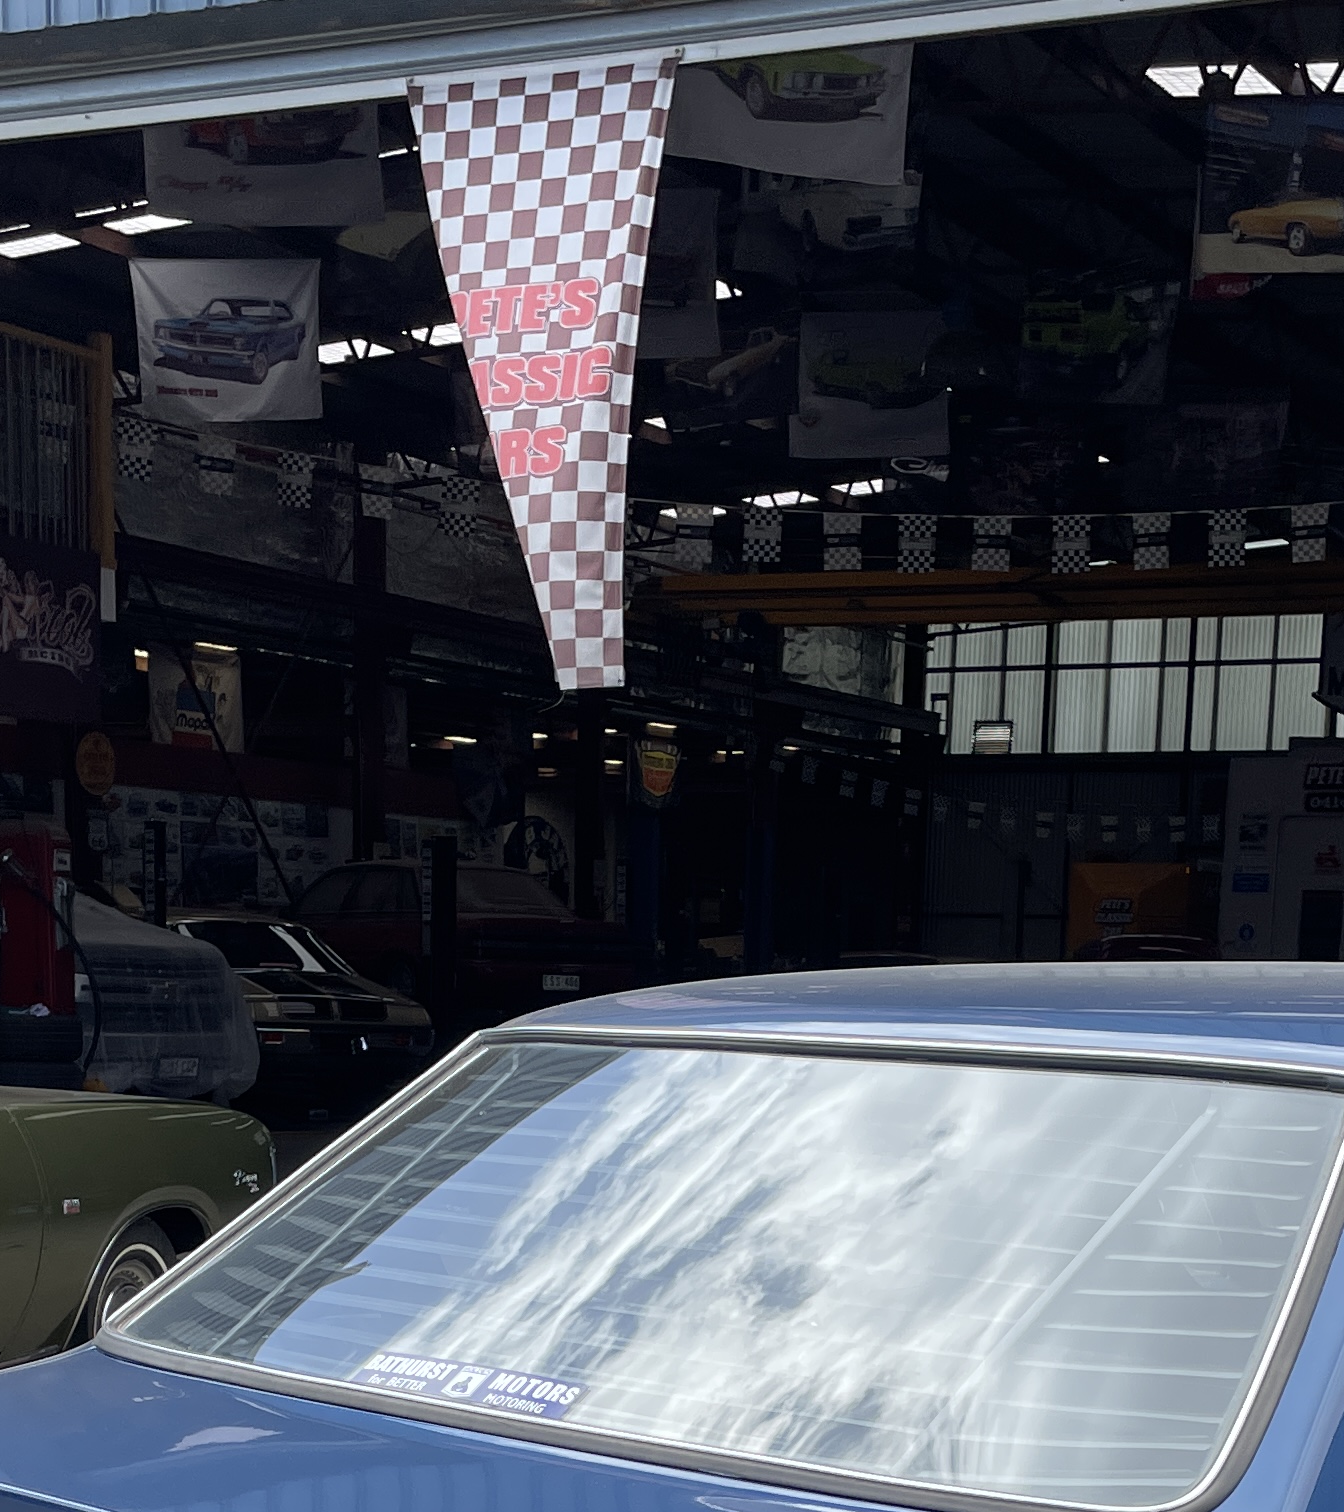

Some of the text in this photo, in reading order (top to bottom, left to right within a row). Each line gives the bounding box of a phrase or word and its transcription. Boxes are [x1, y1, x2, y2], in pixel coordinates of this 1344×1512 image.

[364, 1354, 581, 1406] BATHURST MOTORS
[367, 1374, 427, 1392] for BETTER
[482, 1393, 548, 1415] MOTORING
